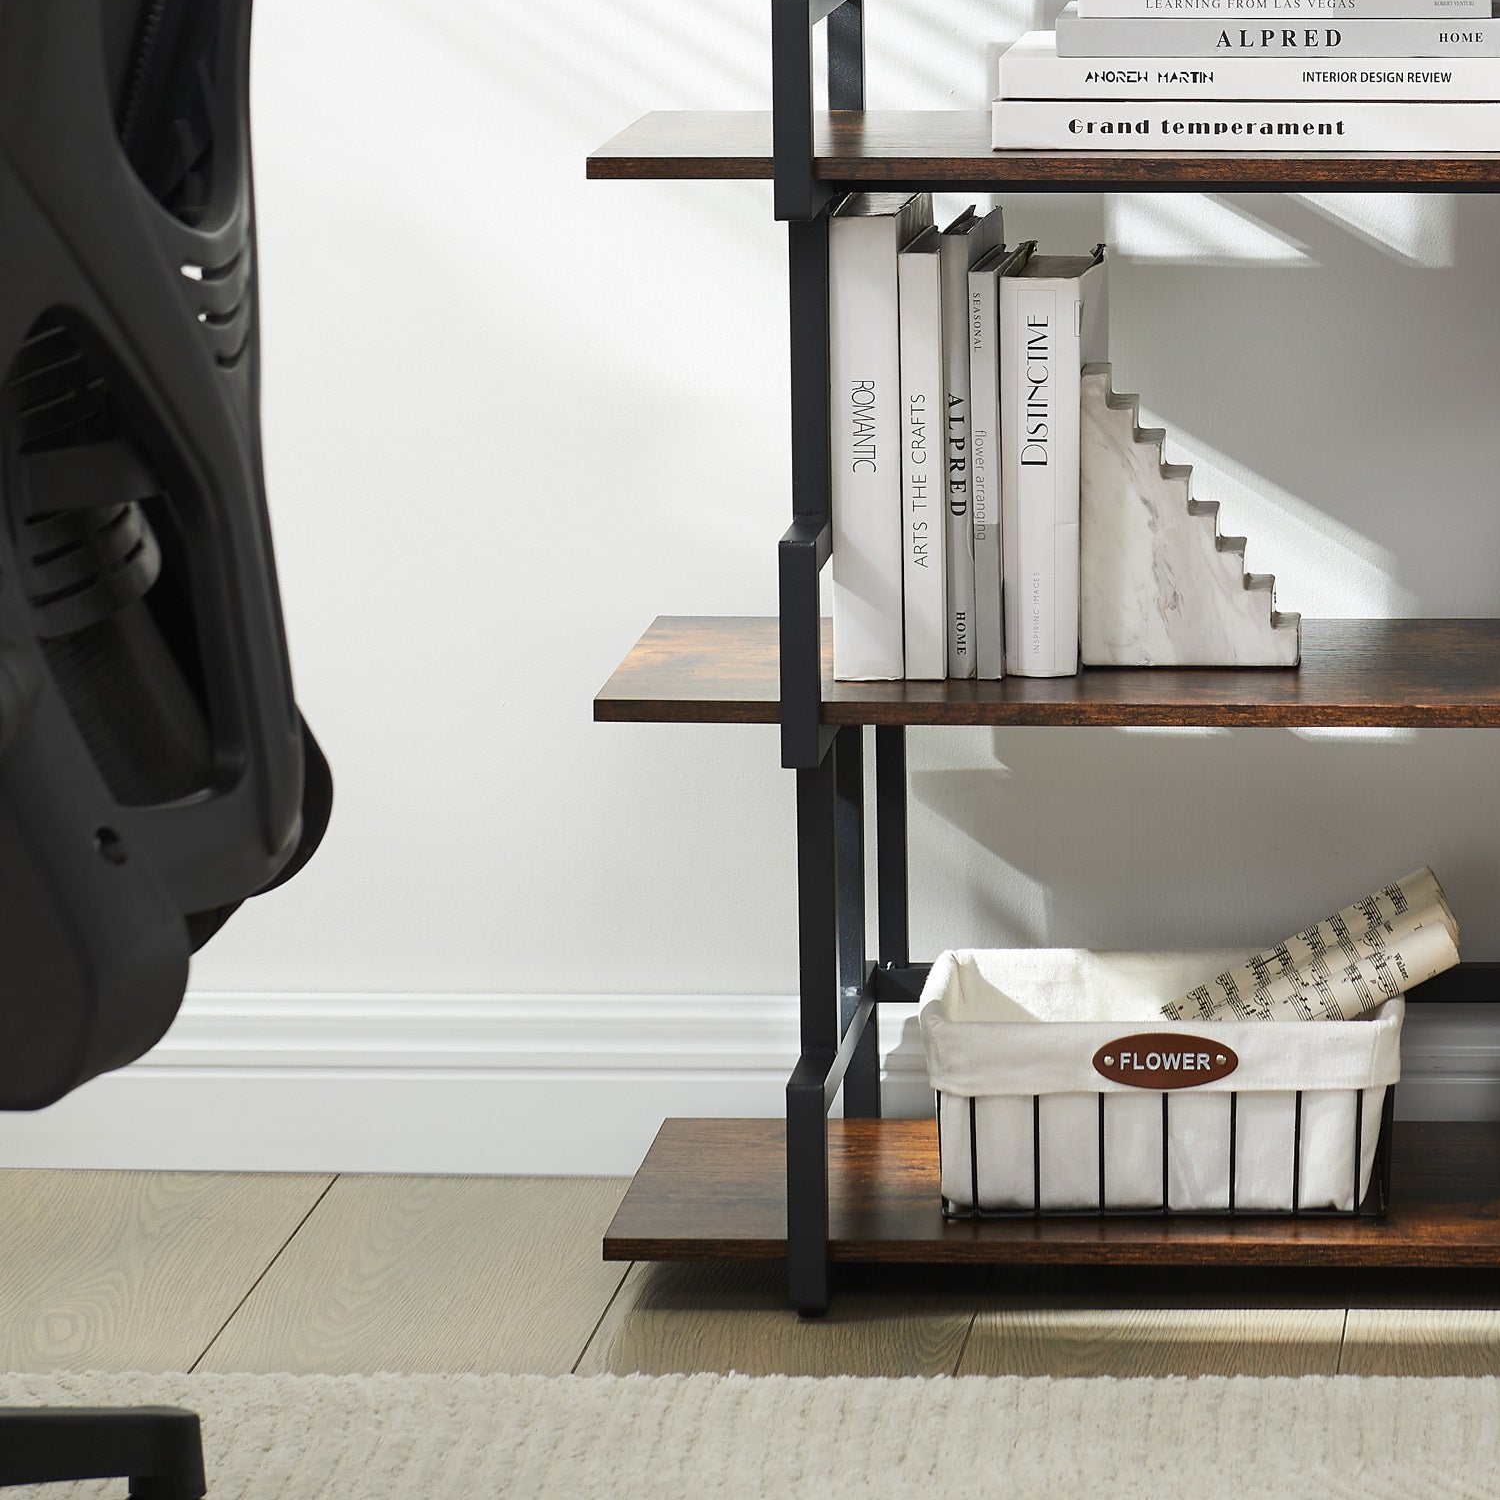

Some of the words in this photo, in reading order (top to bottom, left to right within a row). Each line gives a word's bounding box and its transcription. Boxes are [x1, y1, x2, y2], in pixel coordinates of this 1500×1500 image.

[1147, 0, 1220, 8] LEARNING
[1228, 0, 1266, 8] FROM
[1275, 0, 1300, 8] LAS
[1216, 30, 1341, 47] ALPRED
[1440, 33, 1483, 42] HOME
[1158, 72, 1213, 83] MARTIN
[1303, 72, 1357, 82] INTERIOR
[1361, 72, 1403, 82] DESIGN
[1408, 72, 1451, 82] REVIEW
[1069, 119, 1149, 134] Grand
[1162, 120, 1345, 135] temperament
[973, 293, 981, 352] SEASONAL
[1021, 315, 1048, 465] DISTINCTIVE
[852, 381, 876, 472] ROMANTIC
[910, 395, 926, 464] CRAFTS
[948, 393, 968, 518] ALPRED
[974, 430, 986, 472] flower
[912, 475, 927, 512] THE
[973, 475, 987, 541] arranging
[913, 522, 928, 568] ARTS
[954, 612, 966, 656] HOME
[1032, 609, 1040, 653] INSPIRING
[1119, 1052, 1211, 1071] FLOWER
